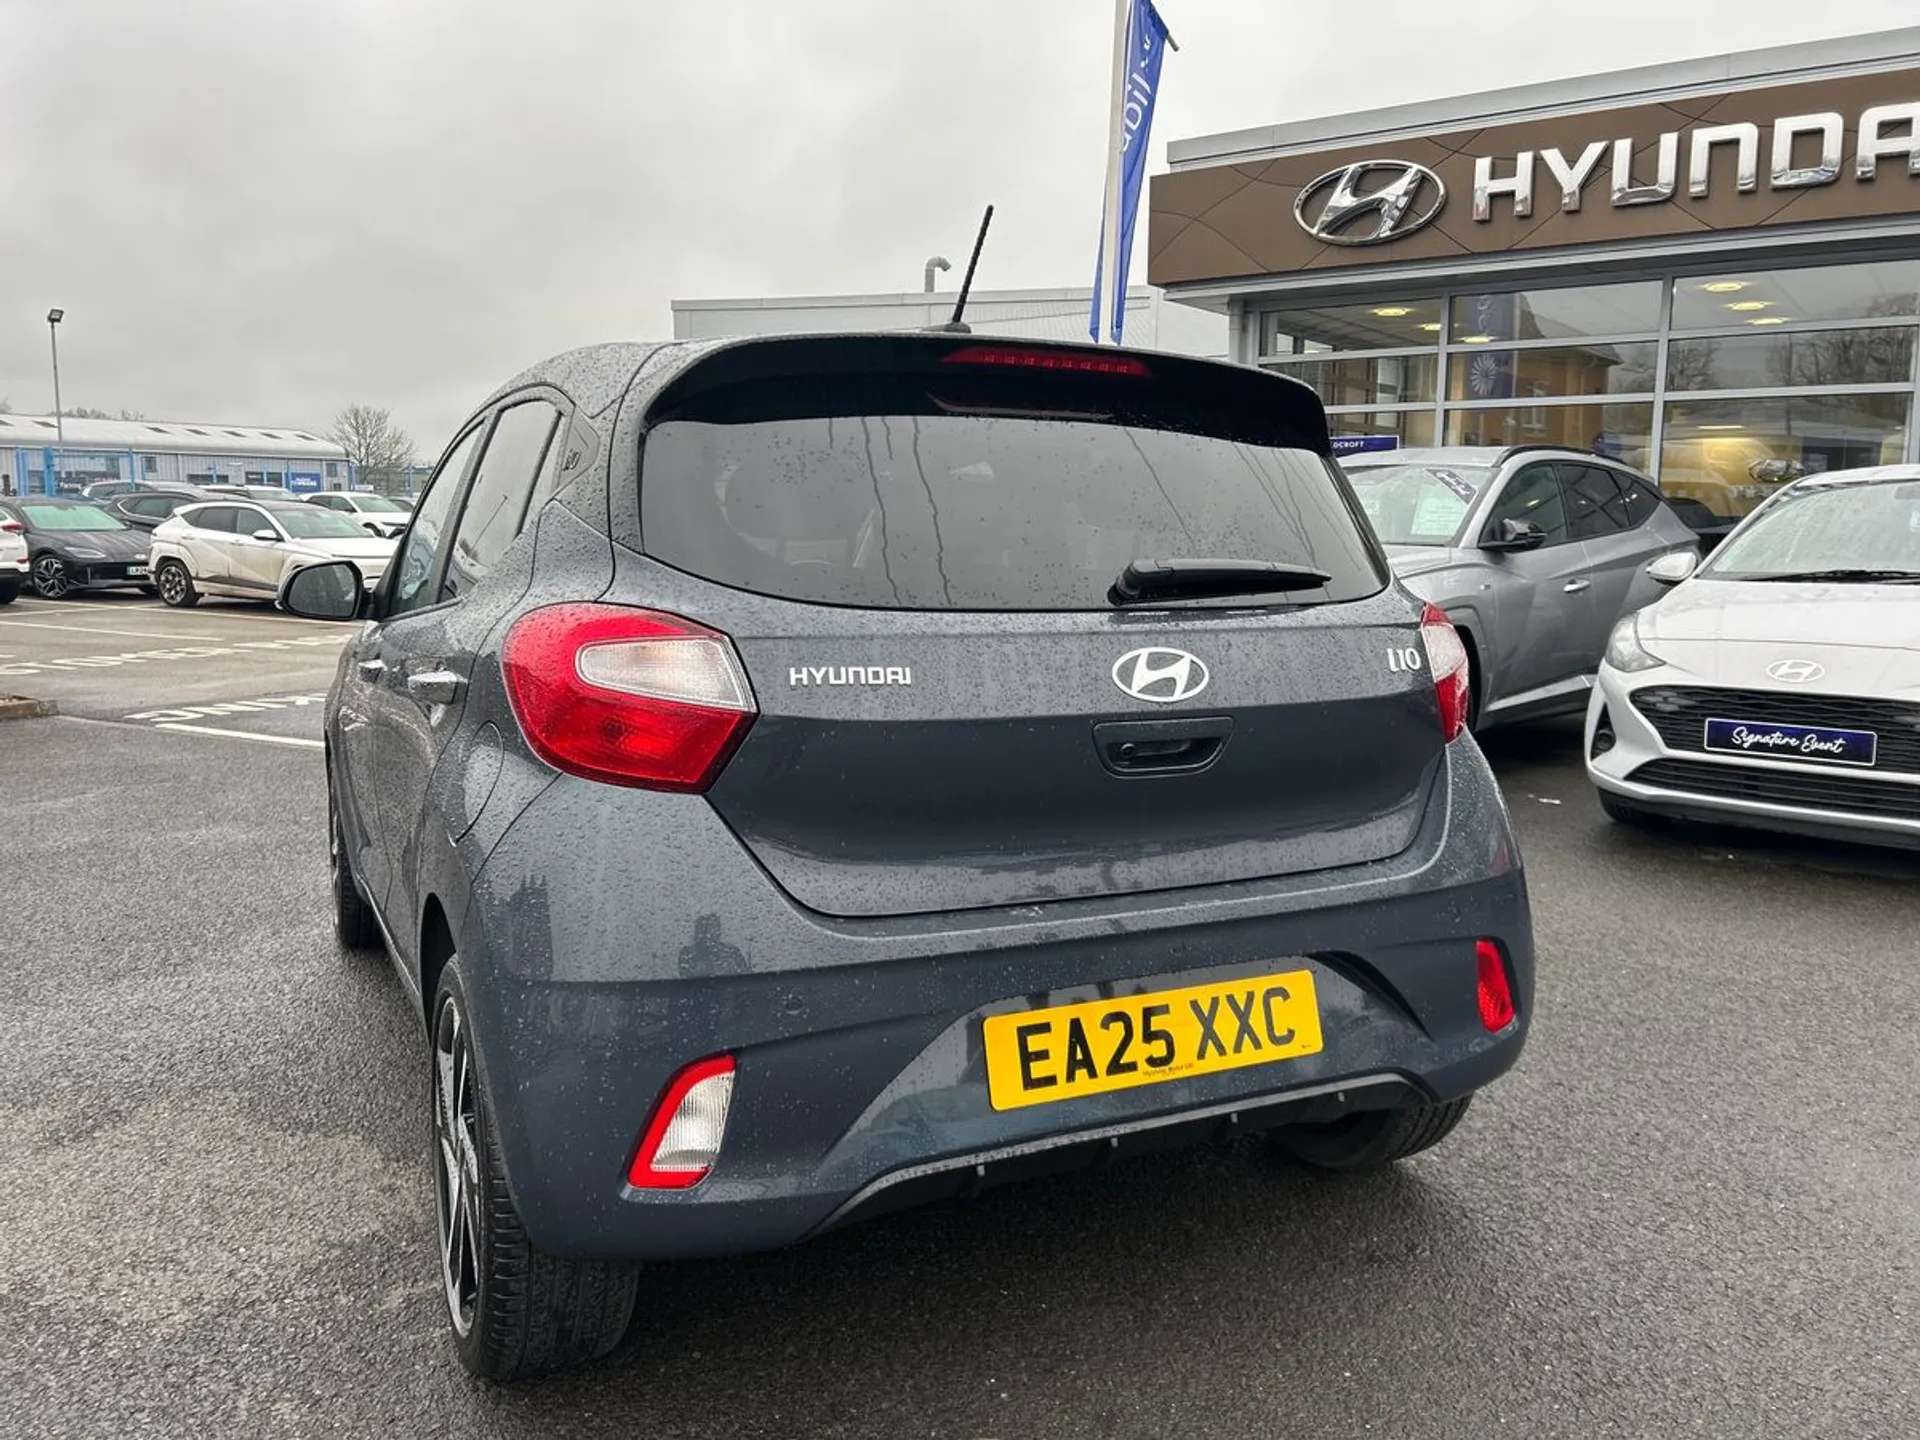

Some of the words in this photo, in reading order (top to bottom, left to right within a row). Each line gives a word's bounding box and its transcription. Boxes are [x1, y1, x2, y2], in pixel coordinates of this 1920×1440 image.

[1472, 102, 1920, 223] HYUNDA
[789, 666, 911, 686] HYUNDAI
[1731, 726, 1800, 749] Signature
[1800, 733, 1847, 754] Event
[1015, 1003, 1176, 1091] EA25
[1189, 986, 1297, 1061] XXC
